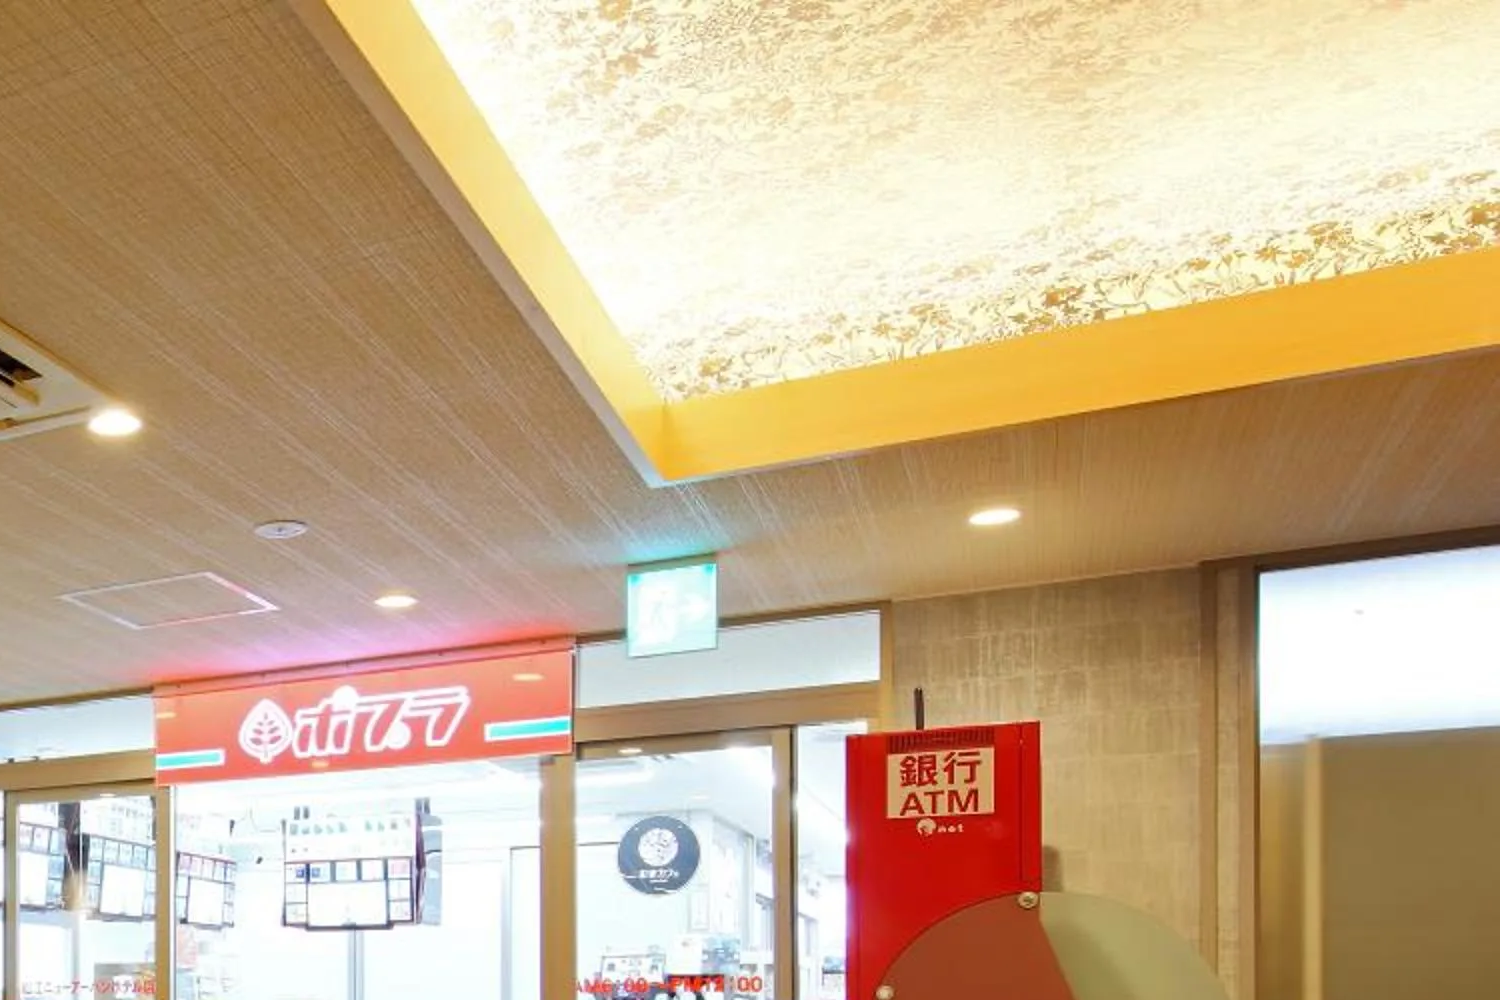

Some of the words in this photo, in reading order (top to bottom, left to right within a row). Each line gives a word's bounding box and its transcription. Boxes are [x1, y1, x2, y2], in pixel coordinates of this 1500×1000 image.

[293, 685, 471, 758] ポプラ
[900, 751, 982, 787] 銀行
[900, 789, 979, 816] ATM
